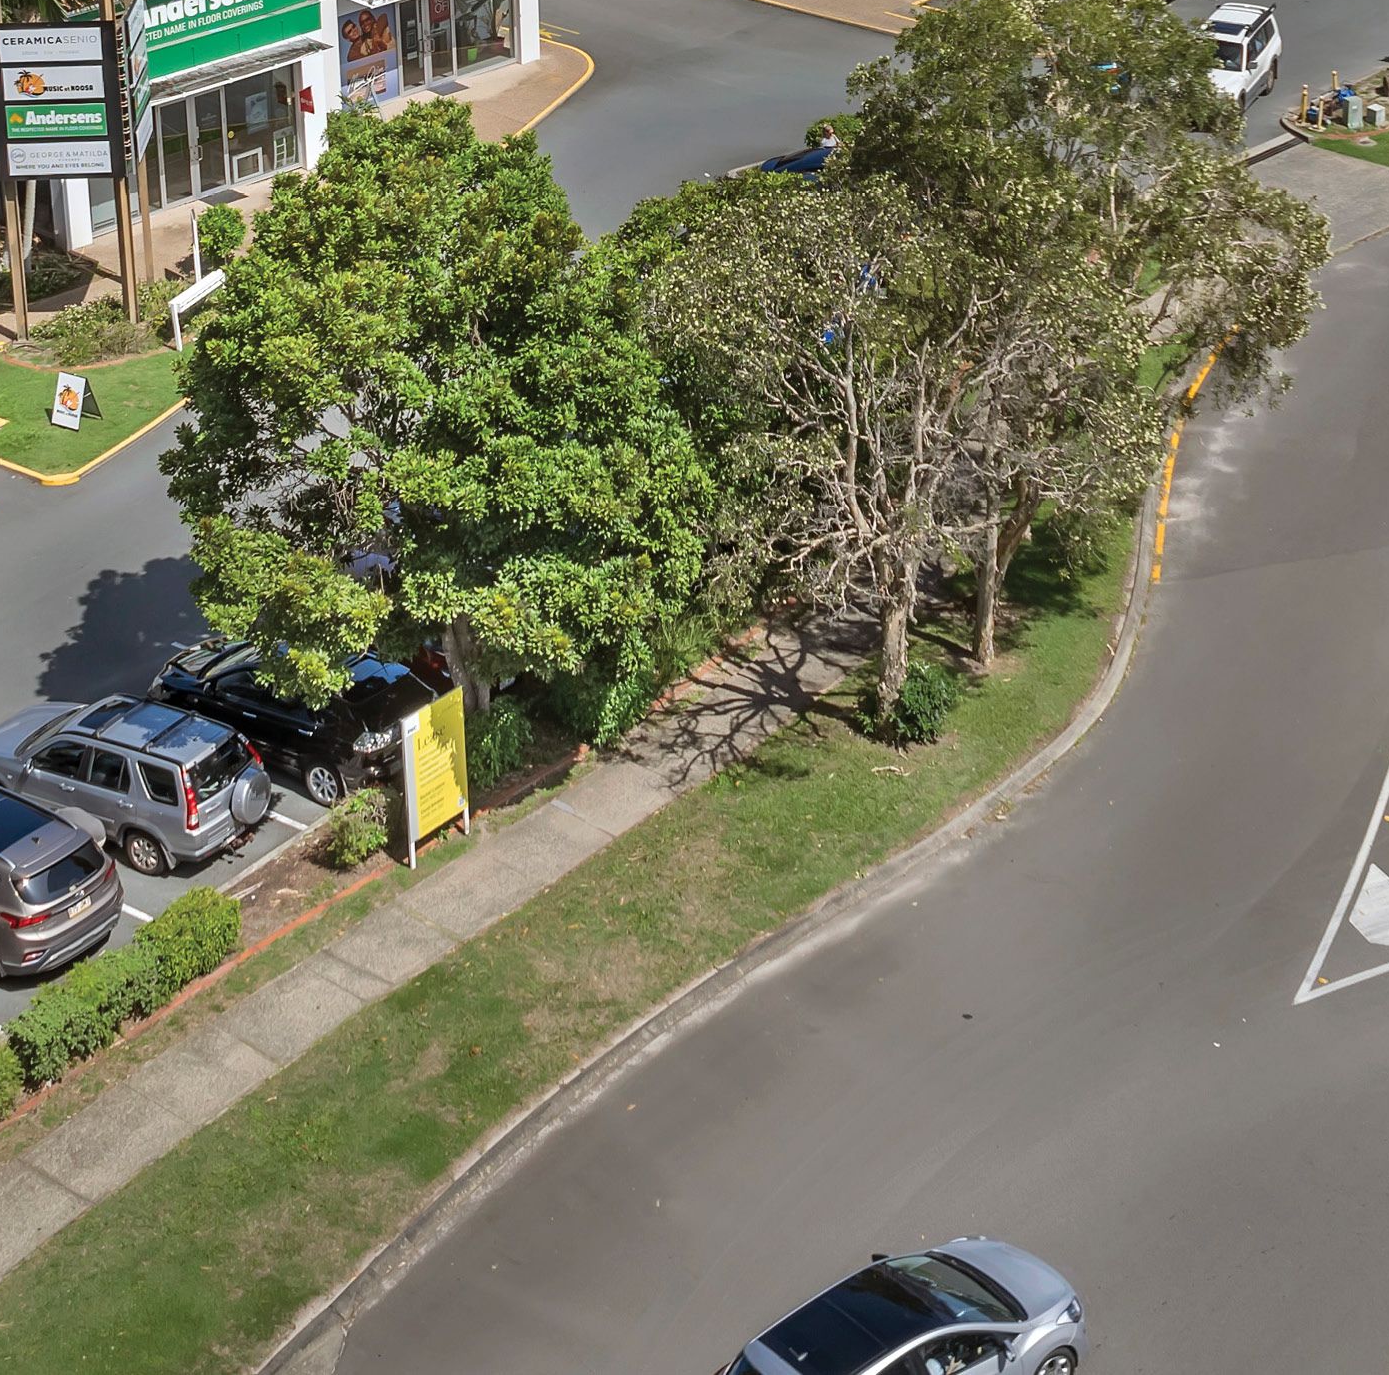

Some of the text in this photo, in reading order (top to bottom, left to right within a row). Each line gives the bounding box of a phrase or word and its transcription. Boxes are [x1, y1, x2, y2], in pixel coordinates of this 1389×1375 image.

[163, 22, 187, 36] NAME
[187, 19, 197, 29] IN
[197, 12, 222, 27] FLOOR
[222, 0, 264, 20] COVERINGS
[2, 35, 98, 46] CERAMICASENIO
[70, 84, 93, 92] NOOSA
[25, 110, 103, 125] Andersens
